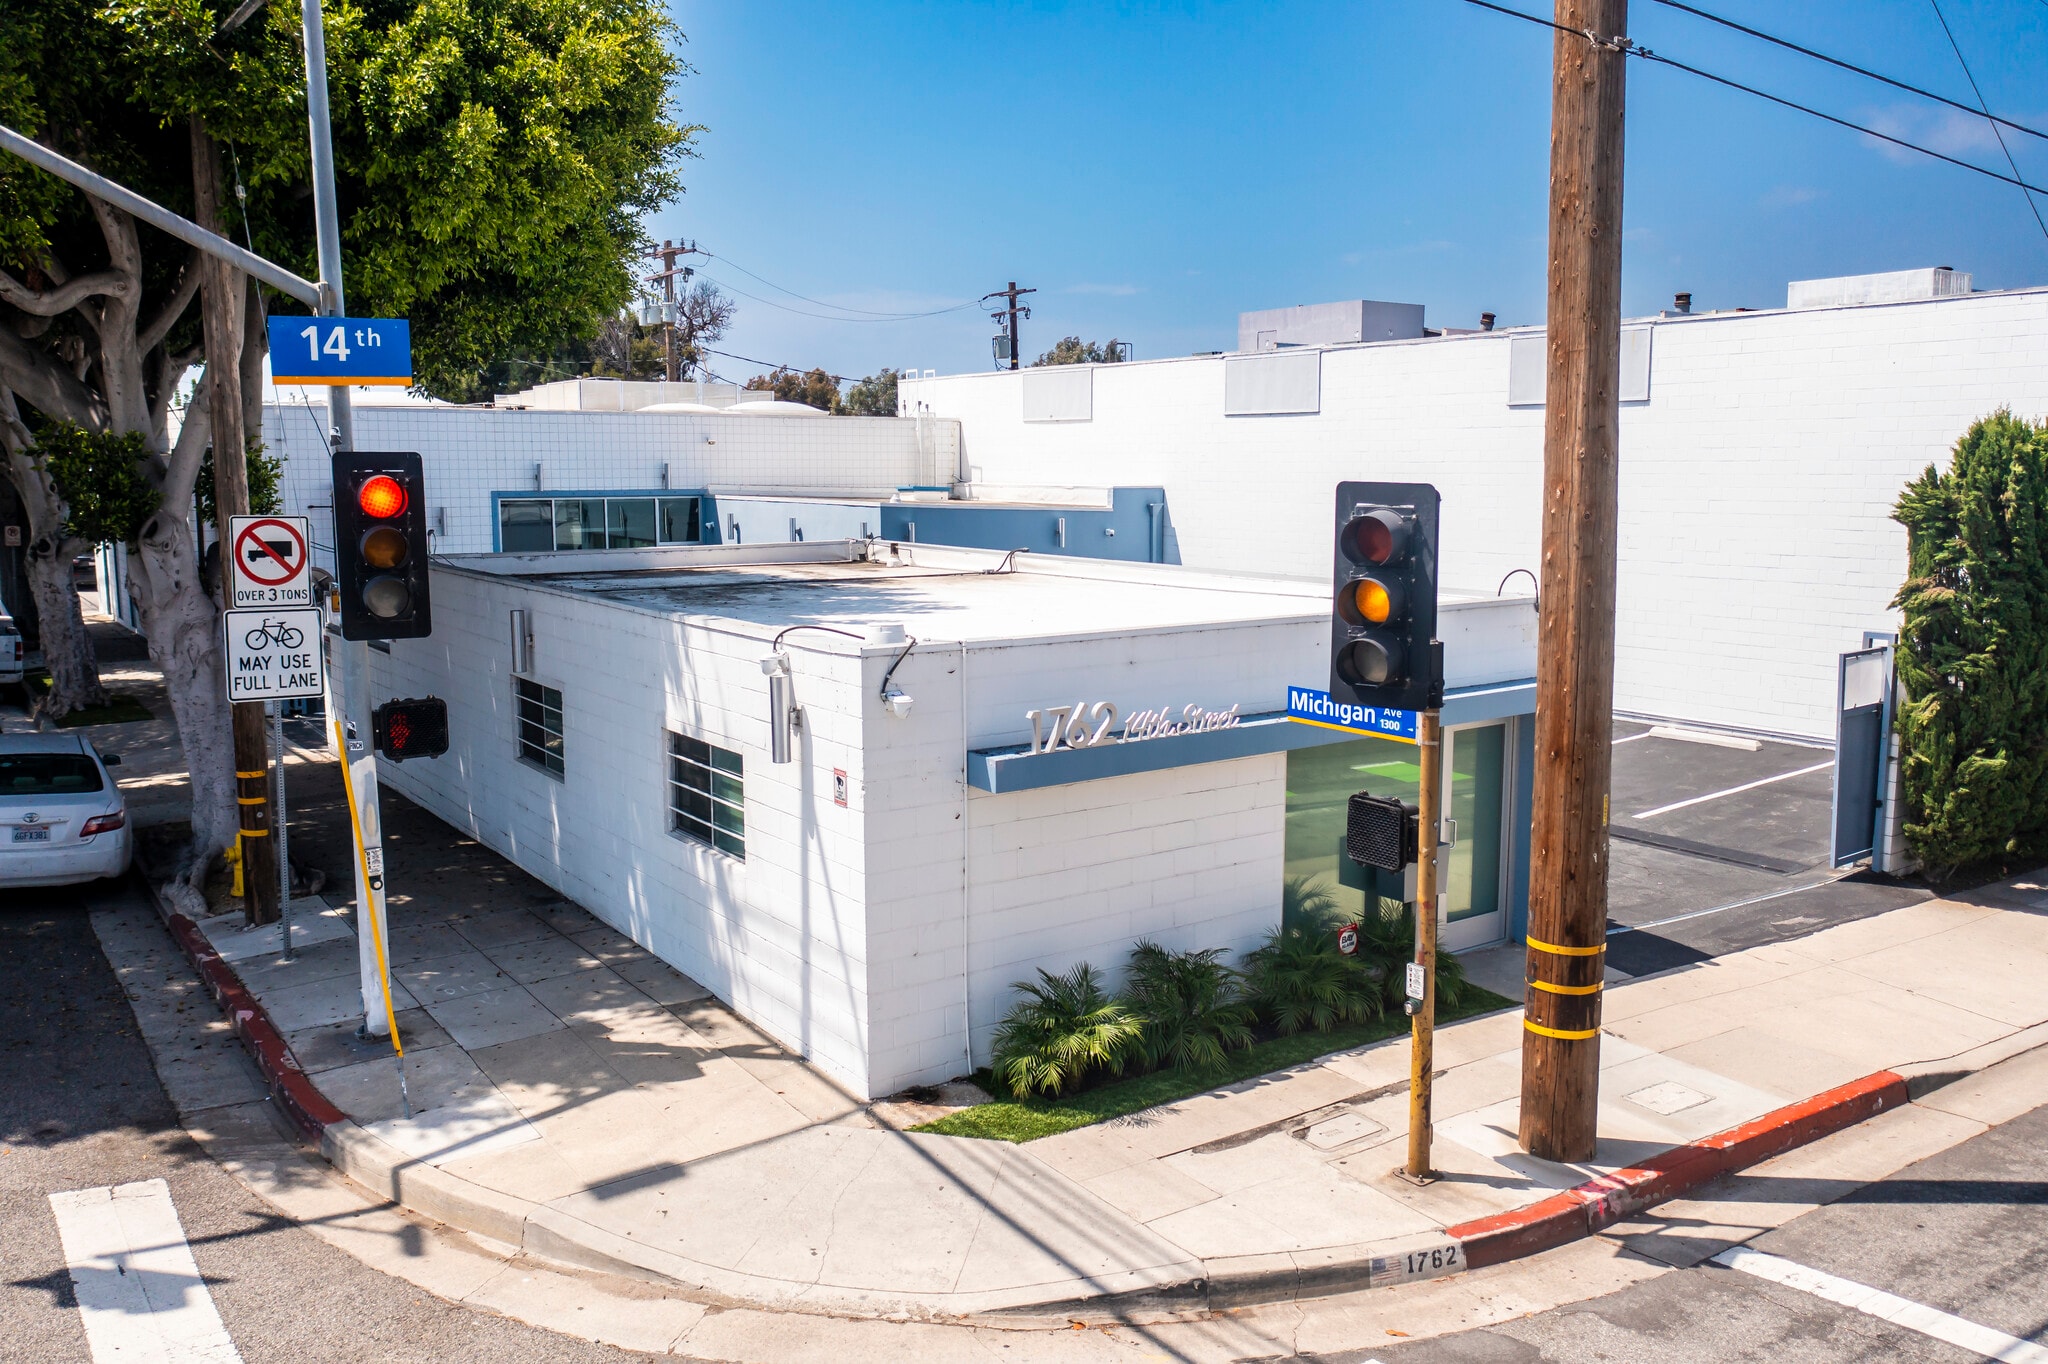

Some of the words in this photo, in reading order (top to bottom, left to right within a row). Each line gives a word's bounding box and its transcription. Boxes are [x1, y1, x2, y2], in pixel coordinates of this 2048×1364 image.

[301, 325, 381, 362] 14th
[237, 590, 265, 601] OVER
[268, 588, 278, 602] 3
[281, 589, 308, 600] TONS
[239, 656, 272, 671] MAY
[281, 654, 311, 669] USE
[234, 675, 271, 691] FULL
[279, 673, 318, 689] LANE
[1291, 690, 1376, 725] Michigan
[1383, 707, 1402, 719] Ave
[1025, 701, 1118, 755] 1762
[1122, 706, 1176, 744] 14th
[1176, 703, 1241, 736] Street
[1380, 719, 1400, 731] 1300
[14, 831, 48, 841] 6GFX381
[1342, 933, 1355, 944] BAY
[1408, 1246, 1457, 1273] 1762
